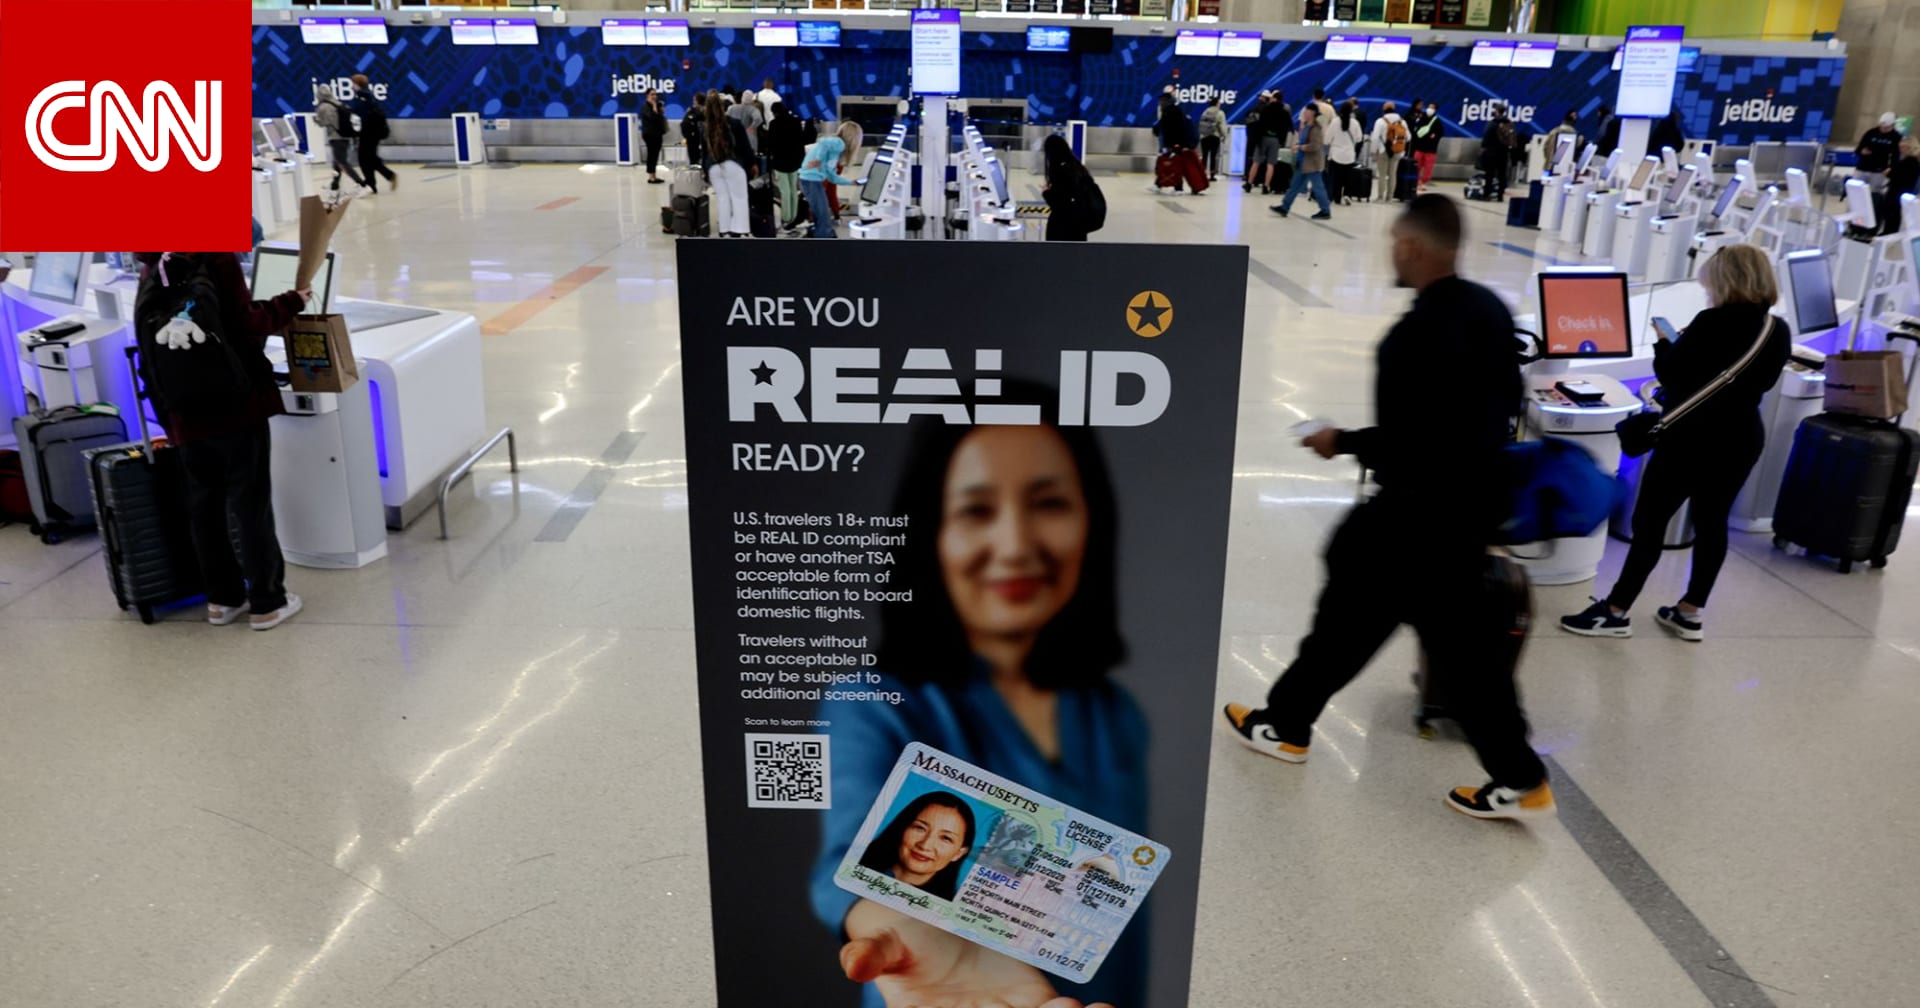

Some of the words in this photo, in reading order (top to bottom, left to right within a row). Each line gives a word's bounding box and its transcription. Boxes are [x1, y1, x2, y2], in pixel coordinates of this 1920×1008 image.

[611, 74, 675, 97] jetBlue
[1719, 98, 1797, 126] jetBlue
[726, 297, 795, 326] ARE
[804, 298, 880, 328] YOU
[726, 346, 1041, 426] REAL
[1058, 350, 1172, 426] ID
[732, 444, 865, 472] READY?
[733, 512, 762, 525] U.S.
[764, 512, 832, 526] travelers
[837, 513, 866, 526] 18+
[870, 514, 910, 527] must
[734, 531, 756, 544] be
[760, 532, 799, 544] REAL
[802, 532, 819, 544] ID
[823, 532, 906, 548] compliant
[735, 552, 752, 563] or
[756, 550, 796, 564] have
[800, 552, 864, 564] another
[866, 552, 895, 564] TSA
[736, 569, 830, 584] acceptable
[834, 570, 870, 582] form
[874, 570, 890, 583] of
[736, 586, 840, 600] identification
[844, 588, 860, 601] to
[864, 589, 912, 602] board
[738, 606, 811, 618] domestic
[814, 606, 865, 622] flights.
[738, 634, 806, 648] Travelers
[810, 635, 868, 648] without
[739, 654, 760, 664] an
[764, 652, 857, 668] acceptable
[861, 654, 877, 666] ID
[740, 672, 774, 684] may
[778, 670, 800, 683] be
[803, 671, 862, 686] subject
[865, 672, 882, 684] to
[740, 688, 820, 700] additional
[824, 688, 906, 705] screening.
[744, 717, 768, 726] Scan
[770, 718, 780, 726] to
[781, 718, 805, 726] learn
[911, 750, 1040, 814] MASSACHUSETTS
[1068, 820, 1112, 844] DRIVER'S
[1066, 830, 1106, 852] LICENSE
[972, 876, 999, 890] HAYLEY
[977, 866, 1020, 890] SAMPLE
[980, 888, 1002, 904] NORTH
[1004, 897, 1019, 911] MAIN
[1020, 904, 1046, 919] STREET
[1076, 882, 1127, 908] 01/12/1978
[961, 897, 983, 912] NORTH
[1038, 948, 1084, 972] 01/12/78
